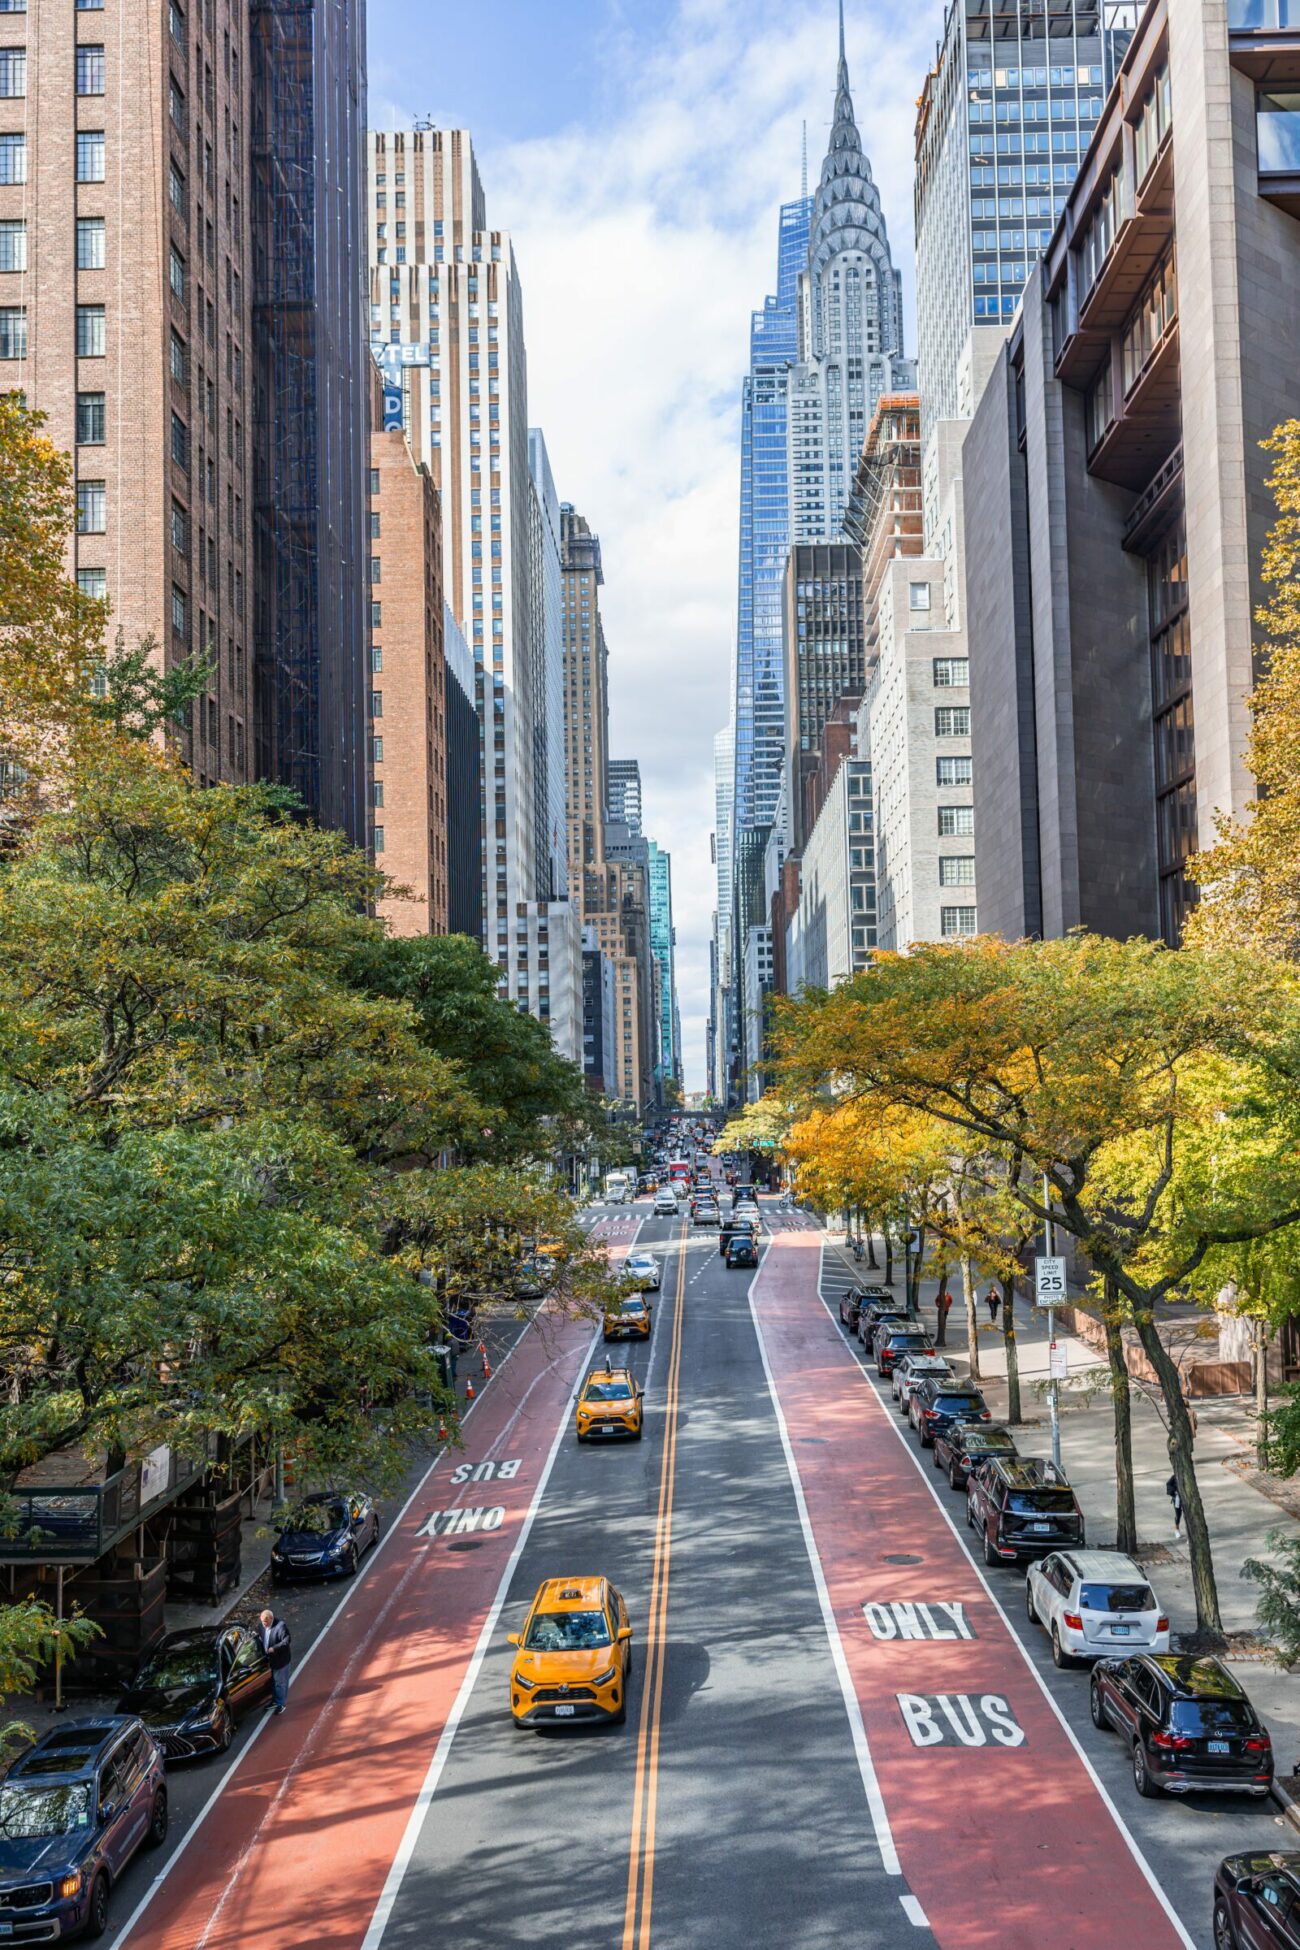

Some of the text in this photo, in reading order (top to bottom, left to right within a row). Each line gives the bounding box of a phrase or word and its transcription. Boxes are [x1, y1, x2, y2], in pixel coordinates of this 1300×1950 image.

[1040, 1277, 1062, 1290] 25
[450, 1459, 522, 1484] BUS
[414, 1505, 506, 1537] ONLY
[862, 1601, 973, 1640] ONLY
[896, 1693, 1025, 1747] BUS
